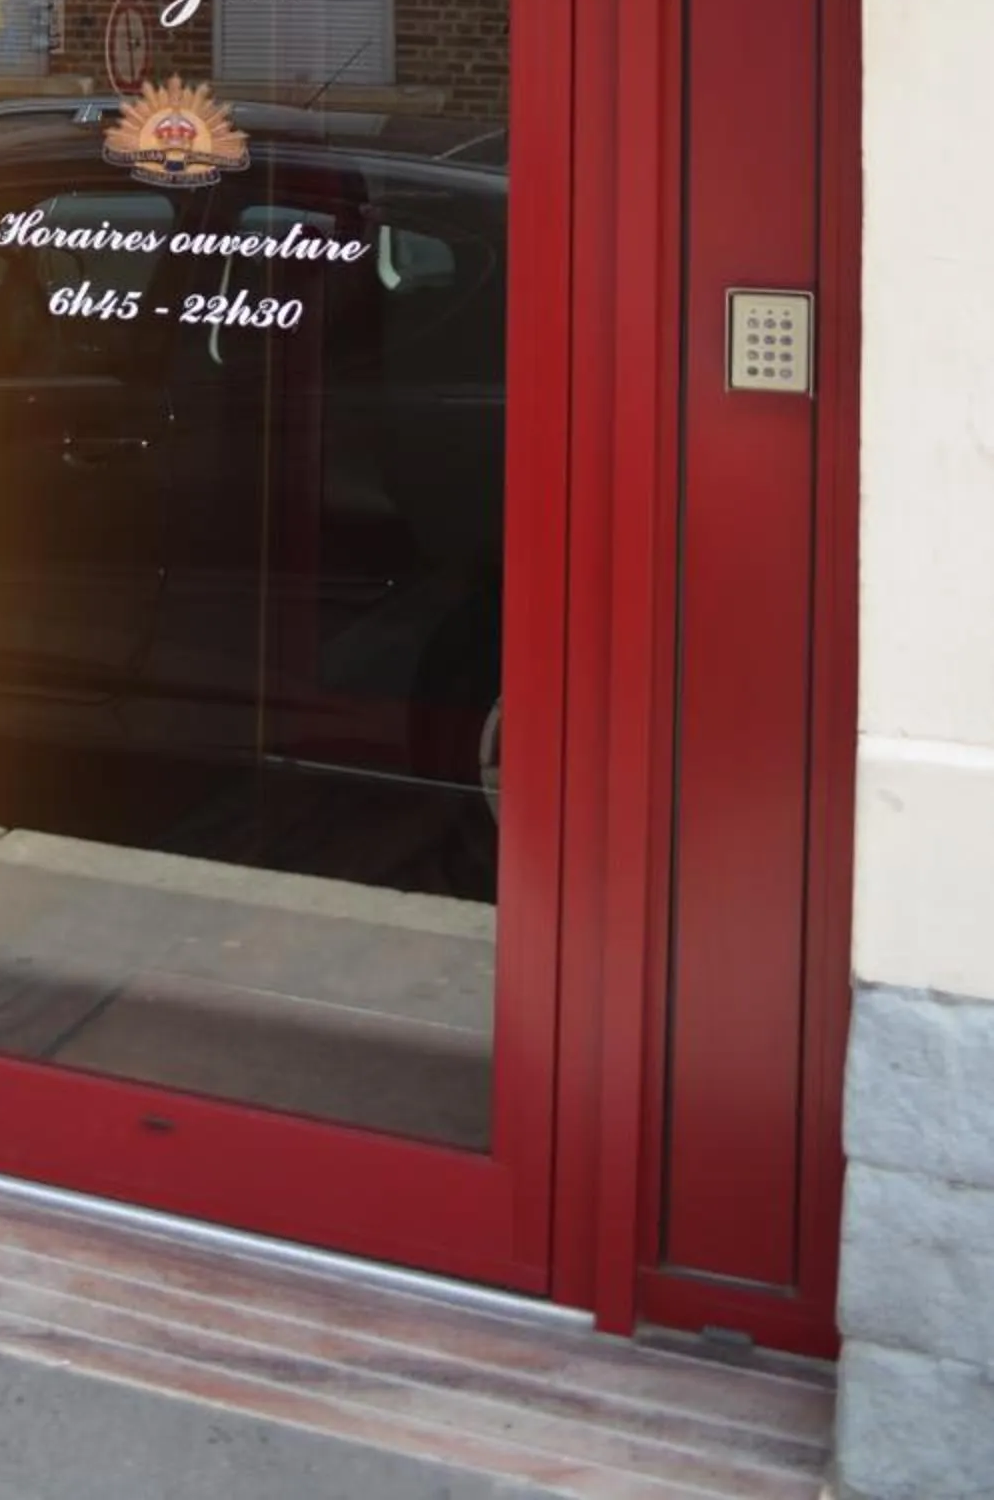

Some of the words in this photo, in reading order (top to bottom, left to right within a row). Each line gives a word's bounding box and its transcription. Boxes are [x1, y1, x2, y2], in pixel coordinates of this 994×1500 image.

[169, 221, 371, 263] ouverture
[48, 285, 142, 321] 6h45
[179, 292, 304, 331] 22h30
